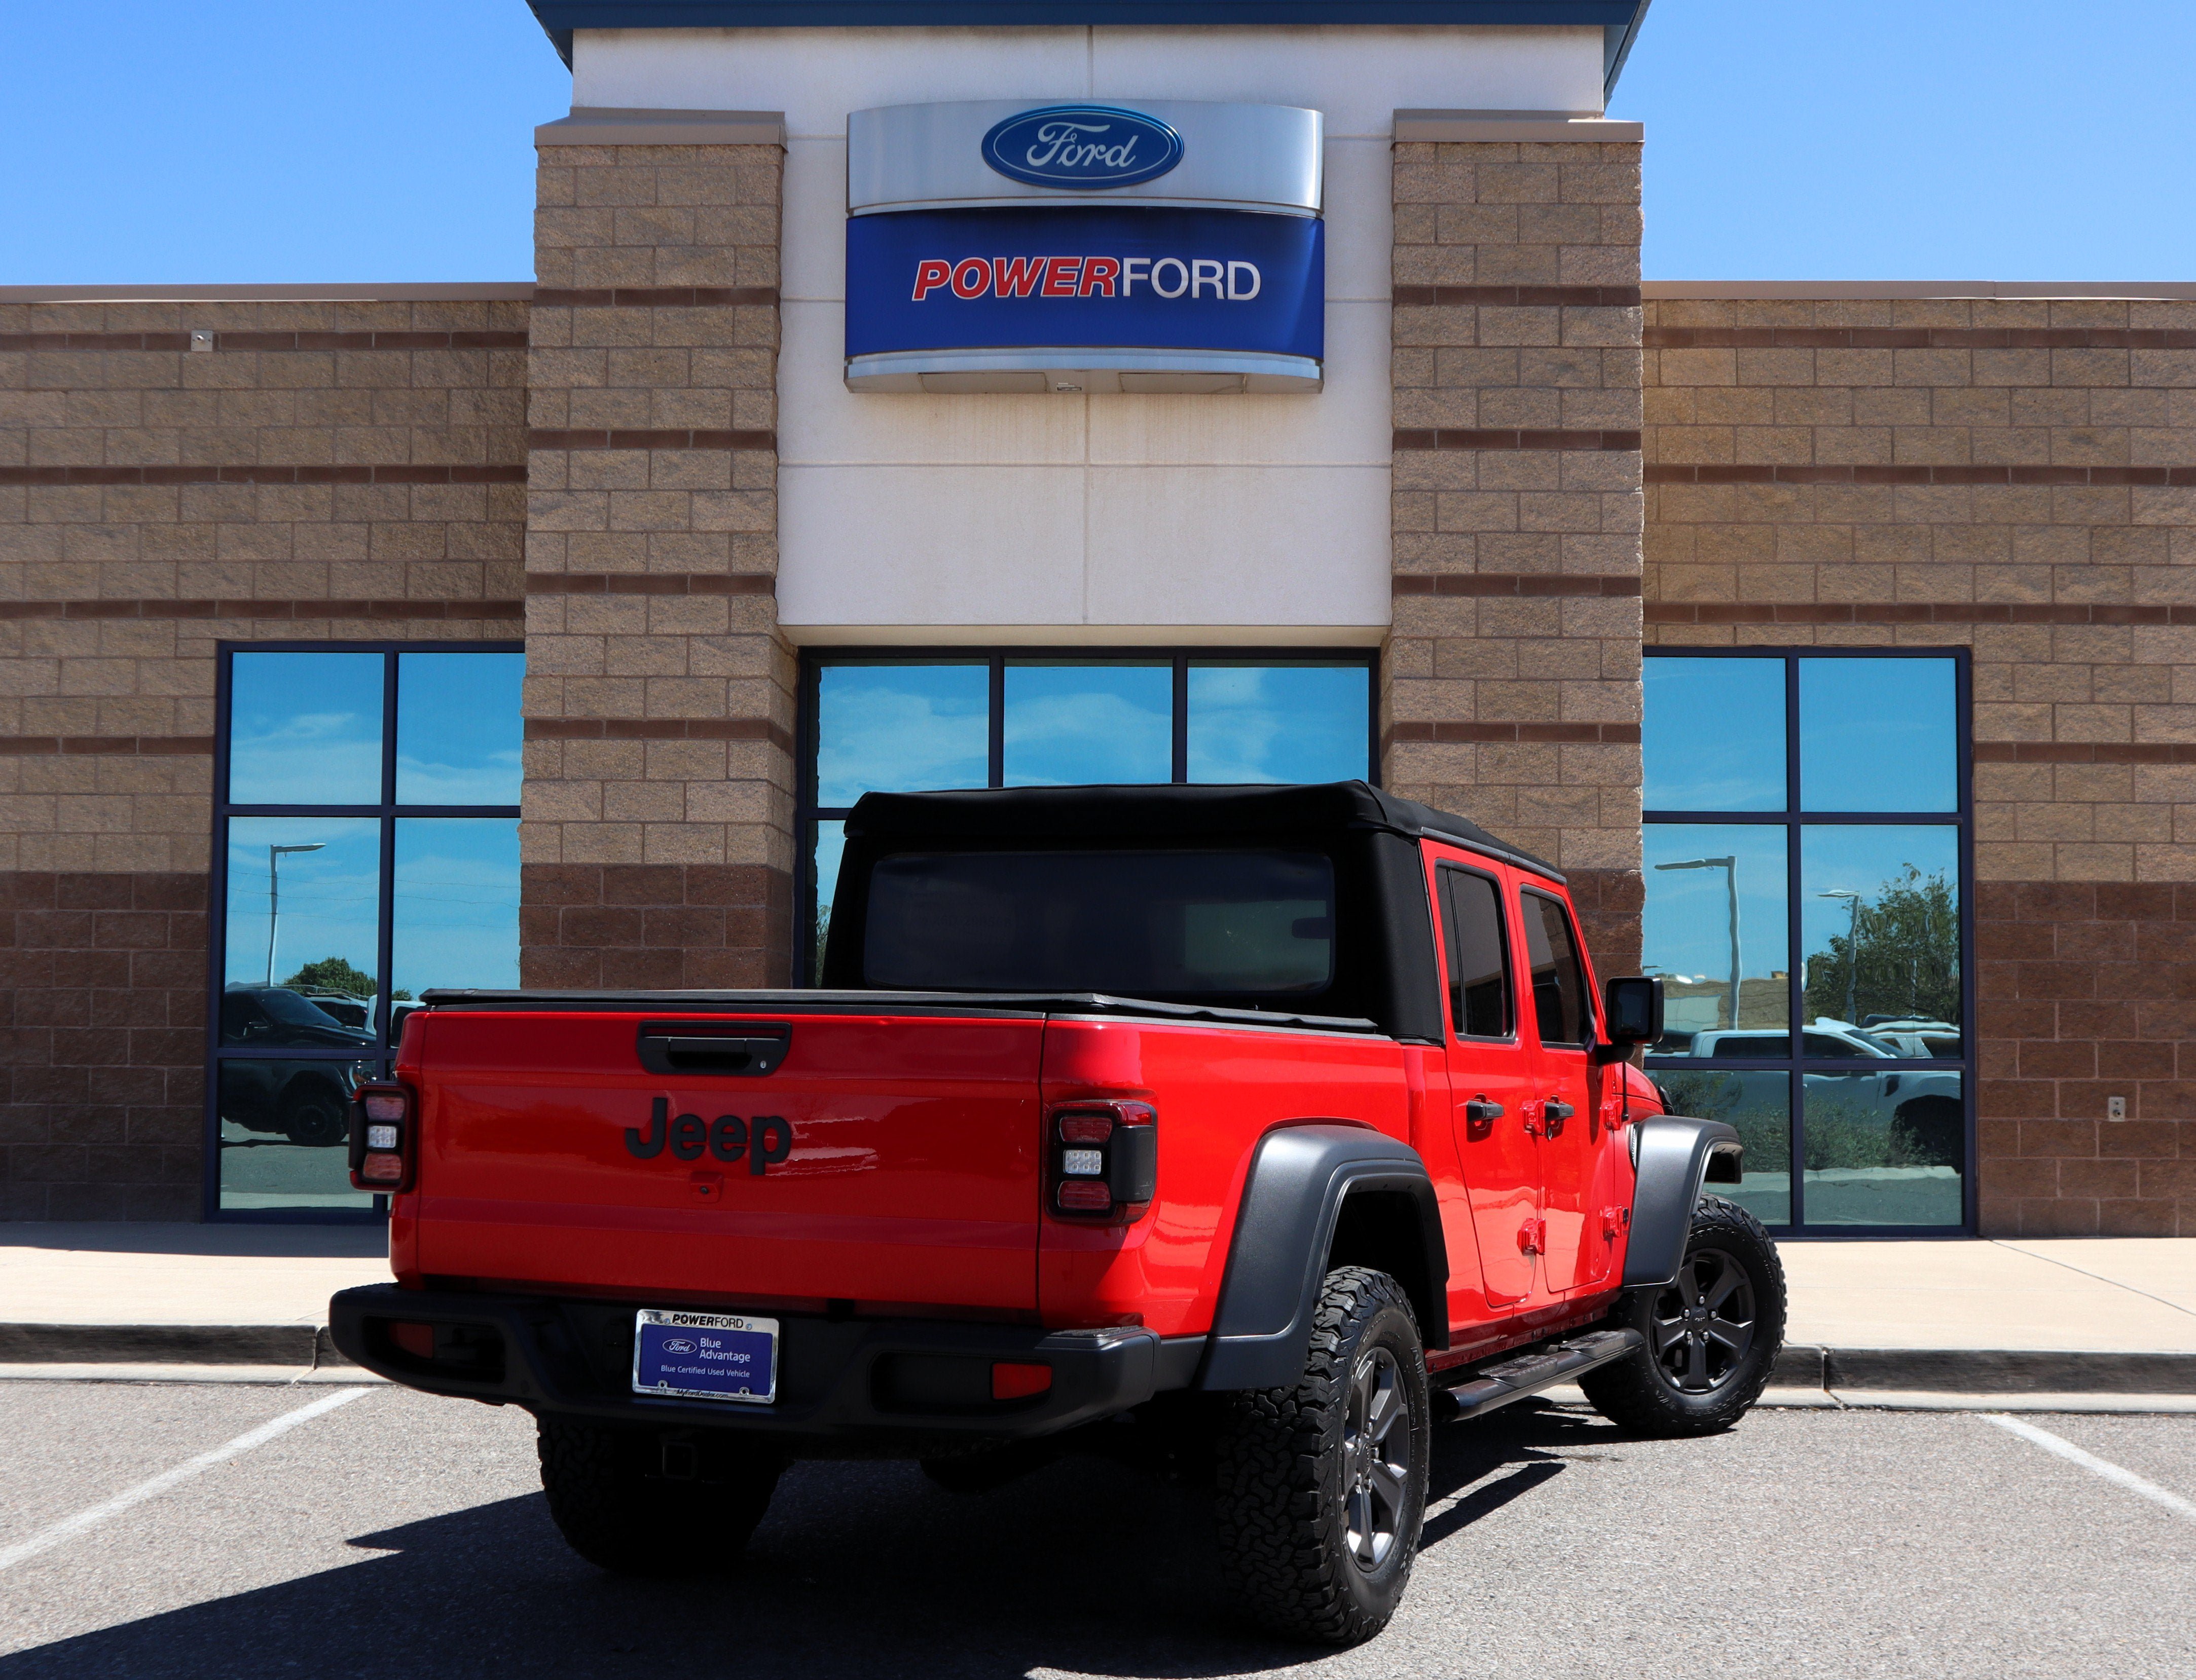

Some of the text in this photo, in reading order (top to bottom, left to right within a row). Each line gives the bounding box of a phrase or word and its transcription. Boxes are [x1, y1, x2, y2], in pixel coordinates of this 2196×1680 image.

[1026, 122, 1139, 168] Ford
[912, 256, 1261, 301] POWERFORD
[625, 1097, 792, 1175] Jeep
[673, 1314, 743, 1328] POWERFORD
[669, 1341, 690, 1352] Ford
[700, 1338, 721, 1348] Blue
[700, 1350, 750, 1363] Advantage
[677, 1366, 706, 1375] Certified
[708, 1368, 724, 1376] Used
